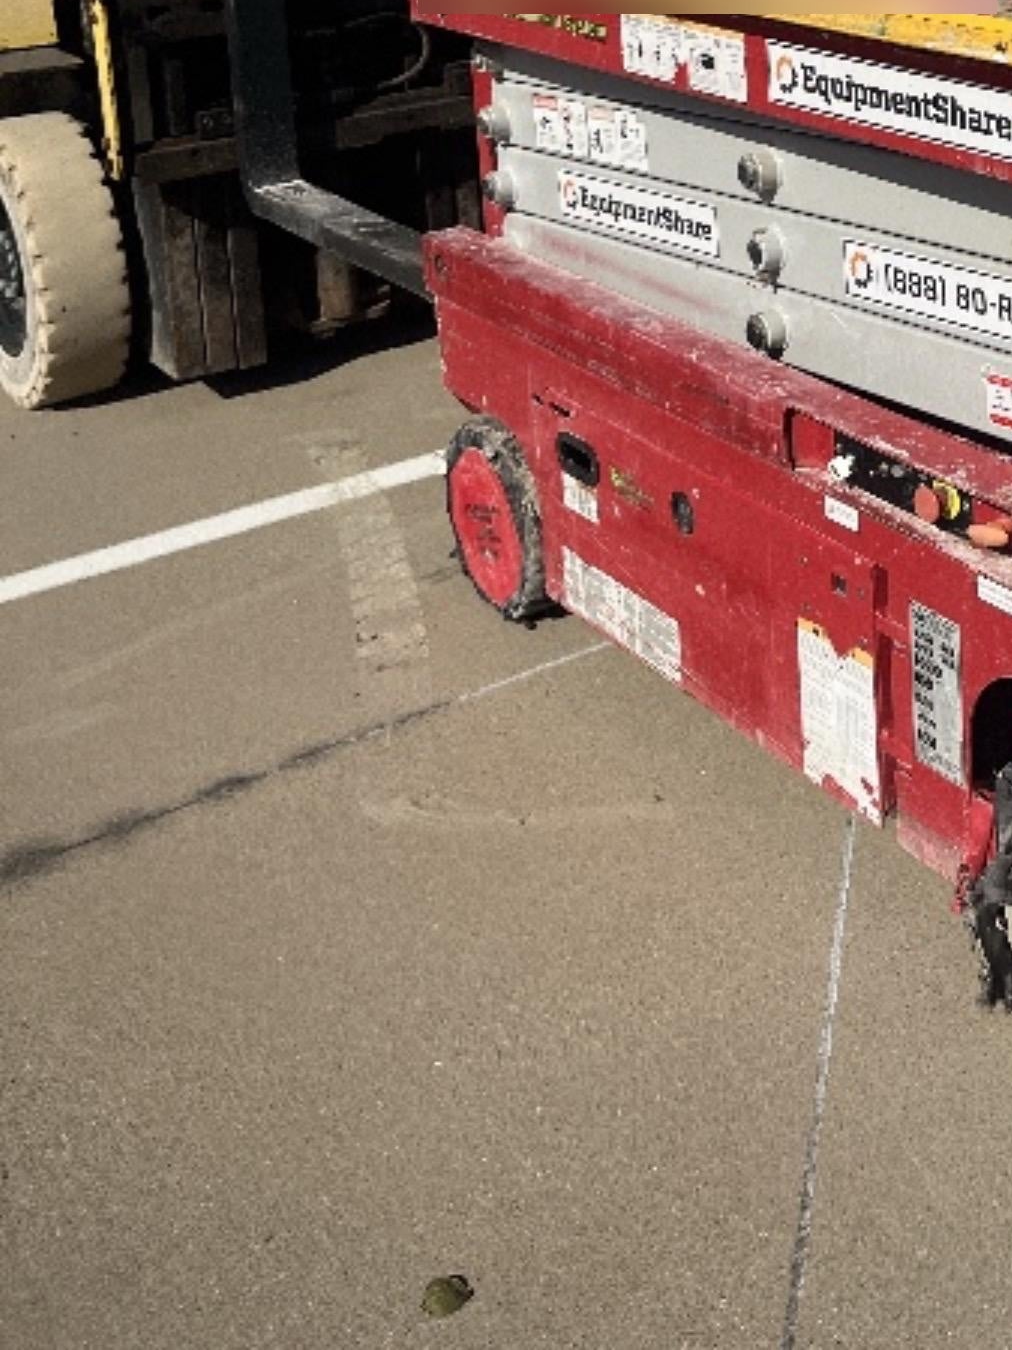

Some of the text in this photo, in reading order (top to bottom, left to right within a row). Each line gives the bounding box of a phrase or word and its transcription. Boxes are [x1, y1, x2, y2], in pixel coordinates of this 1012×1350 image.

[800, 63, 1012, 141] EquipmentShare
[578, 186, 713, 241] EquipmentShare
[884, 263, 946, 307] (888)
